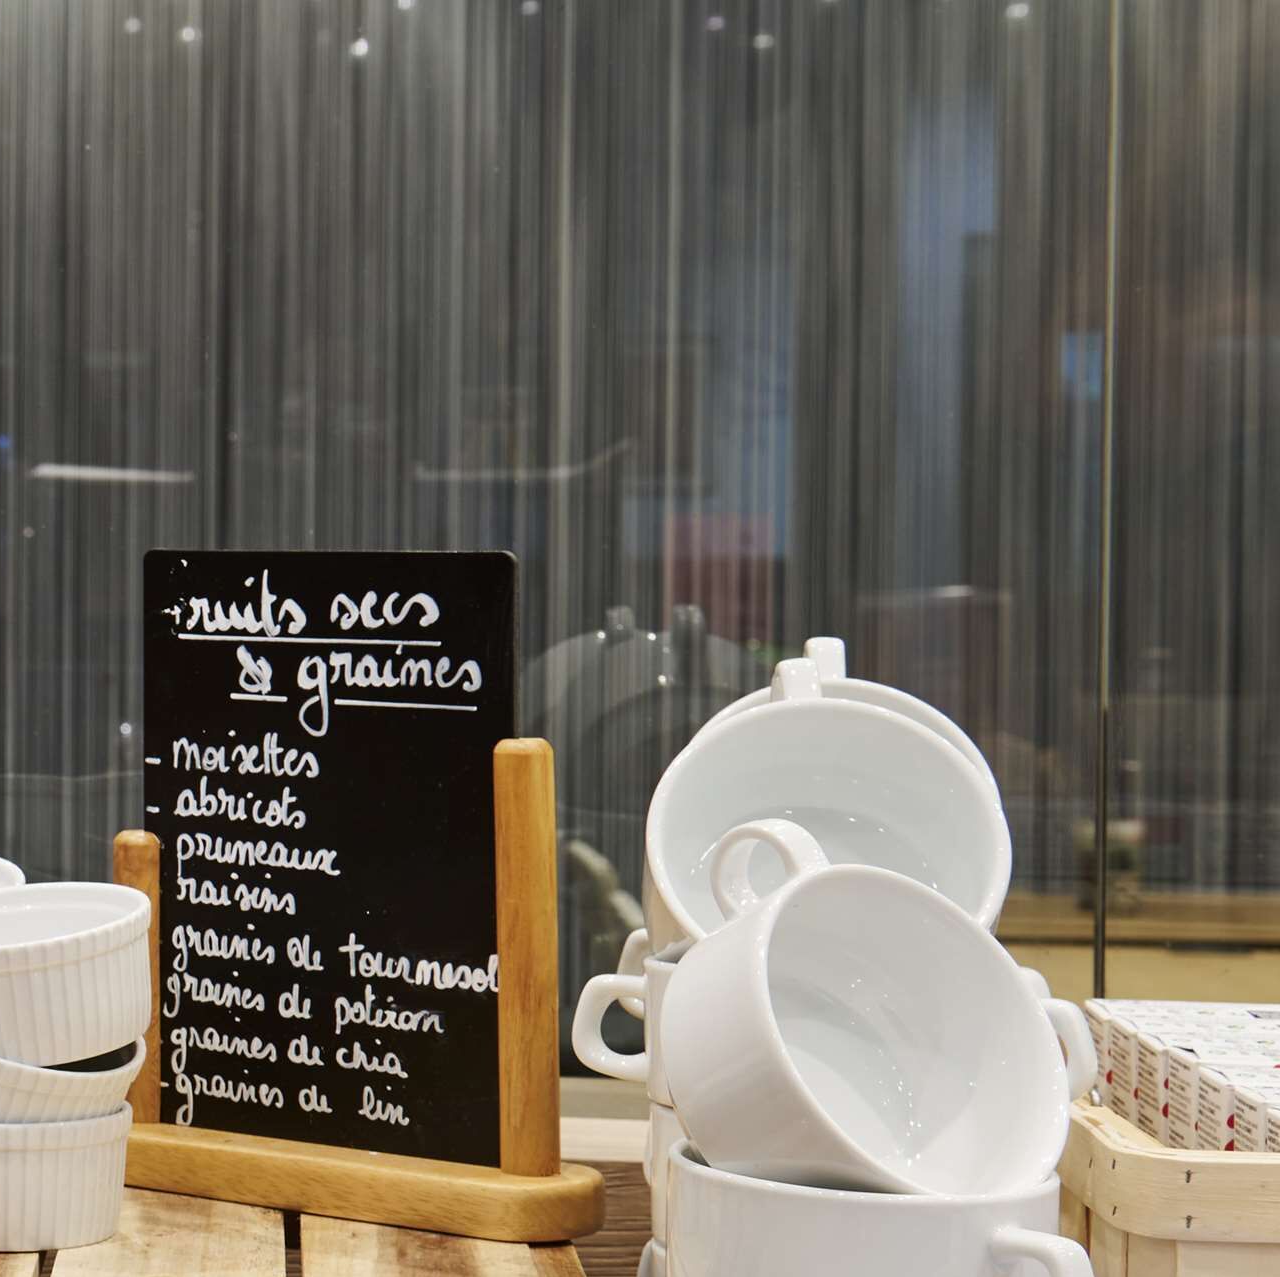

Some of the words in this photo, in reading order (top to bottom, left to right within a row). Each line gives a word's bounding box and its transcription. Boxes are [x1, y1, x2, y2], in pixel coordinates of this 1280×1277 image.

[330, 590, 441, 630] secs
[297, 645, 483, 738] graines
[174, 775, 307, 830] abricots
[176, 832, 341, 877] pruneaux
[176, 871, 297, 916] raisins
[172, 923, 276, 973] graines
[286, 934, 325, 972] de
[338, 932, 500, 993] tournesol
[163, 971, 266, 1019] graines
[278, 983, 312, 1020] de
[170, 1017, 278, 1073] graines
[287, 1034, 325, 1067] de
[335, 1037, 409, 1079] chia
[298, 1084, 333, 1115] de
[358, 1084, 410, 1127] lin
